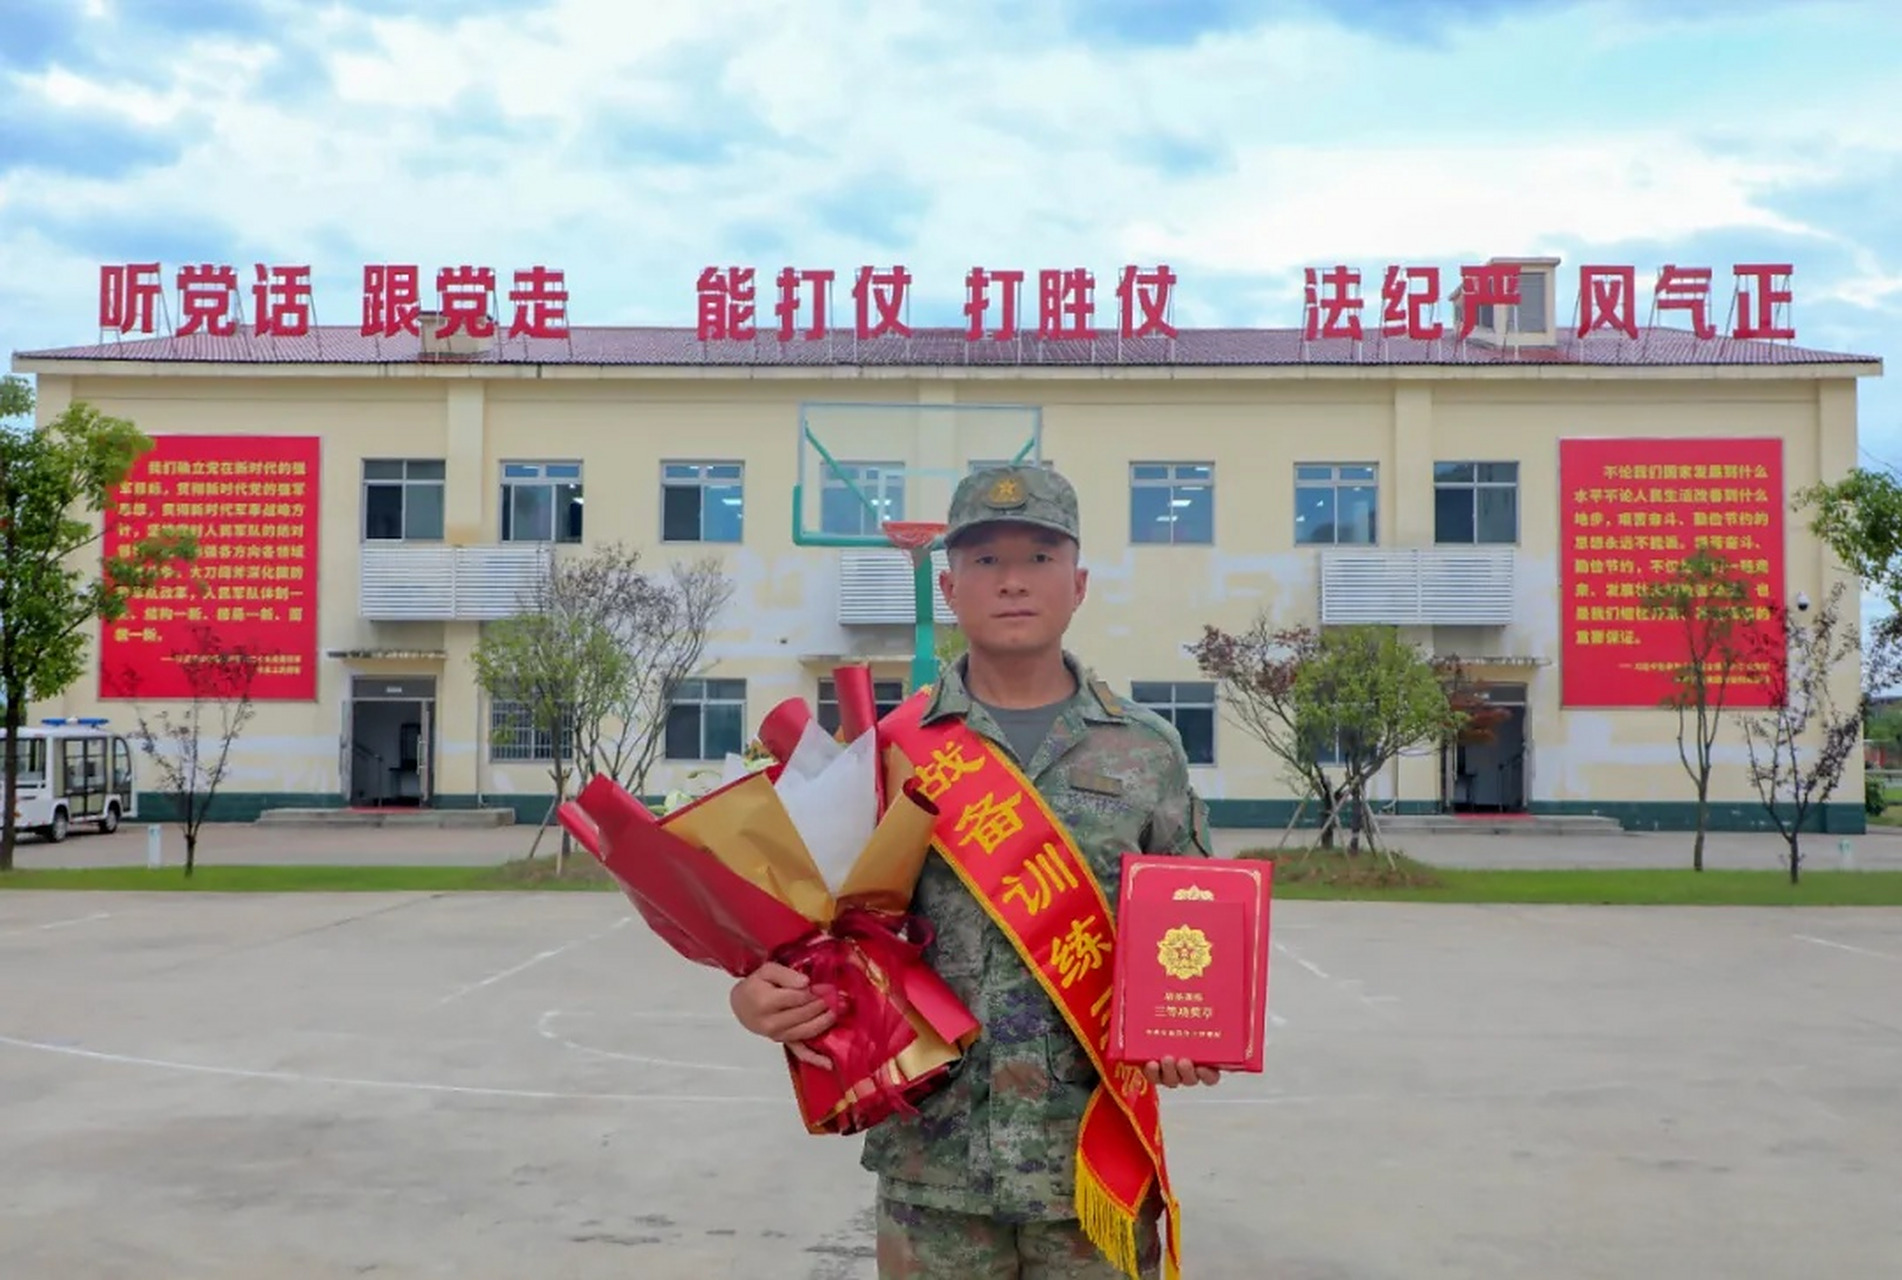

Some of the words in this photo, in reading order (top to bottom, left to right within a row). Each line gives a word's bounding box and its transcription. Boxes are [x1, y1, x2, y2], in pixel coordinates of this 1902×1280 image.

[100, 262, 311, 338] 听党话
[361, 264, 569, 339] 跟党走
[697, 265, 912, 341] 能打仗
[964, 265, 1177, 341] 打胜仗
[1304, 265, 1522, 340] 法纪严
[1578, 264, 1795, 340] 风气正
